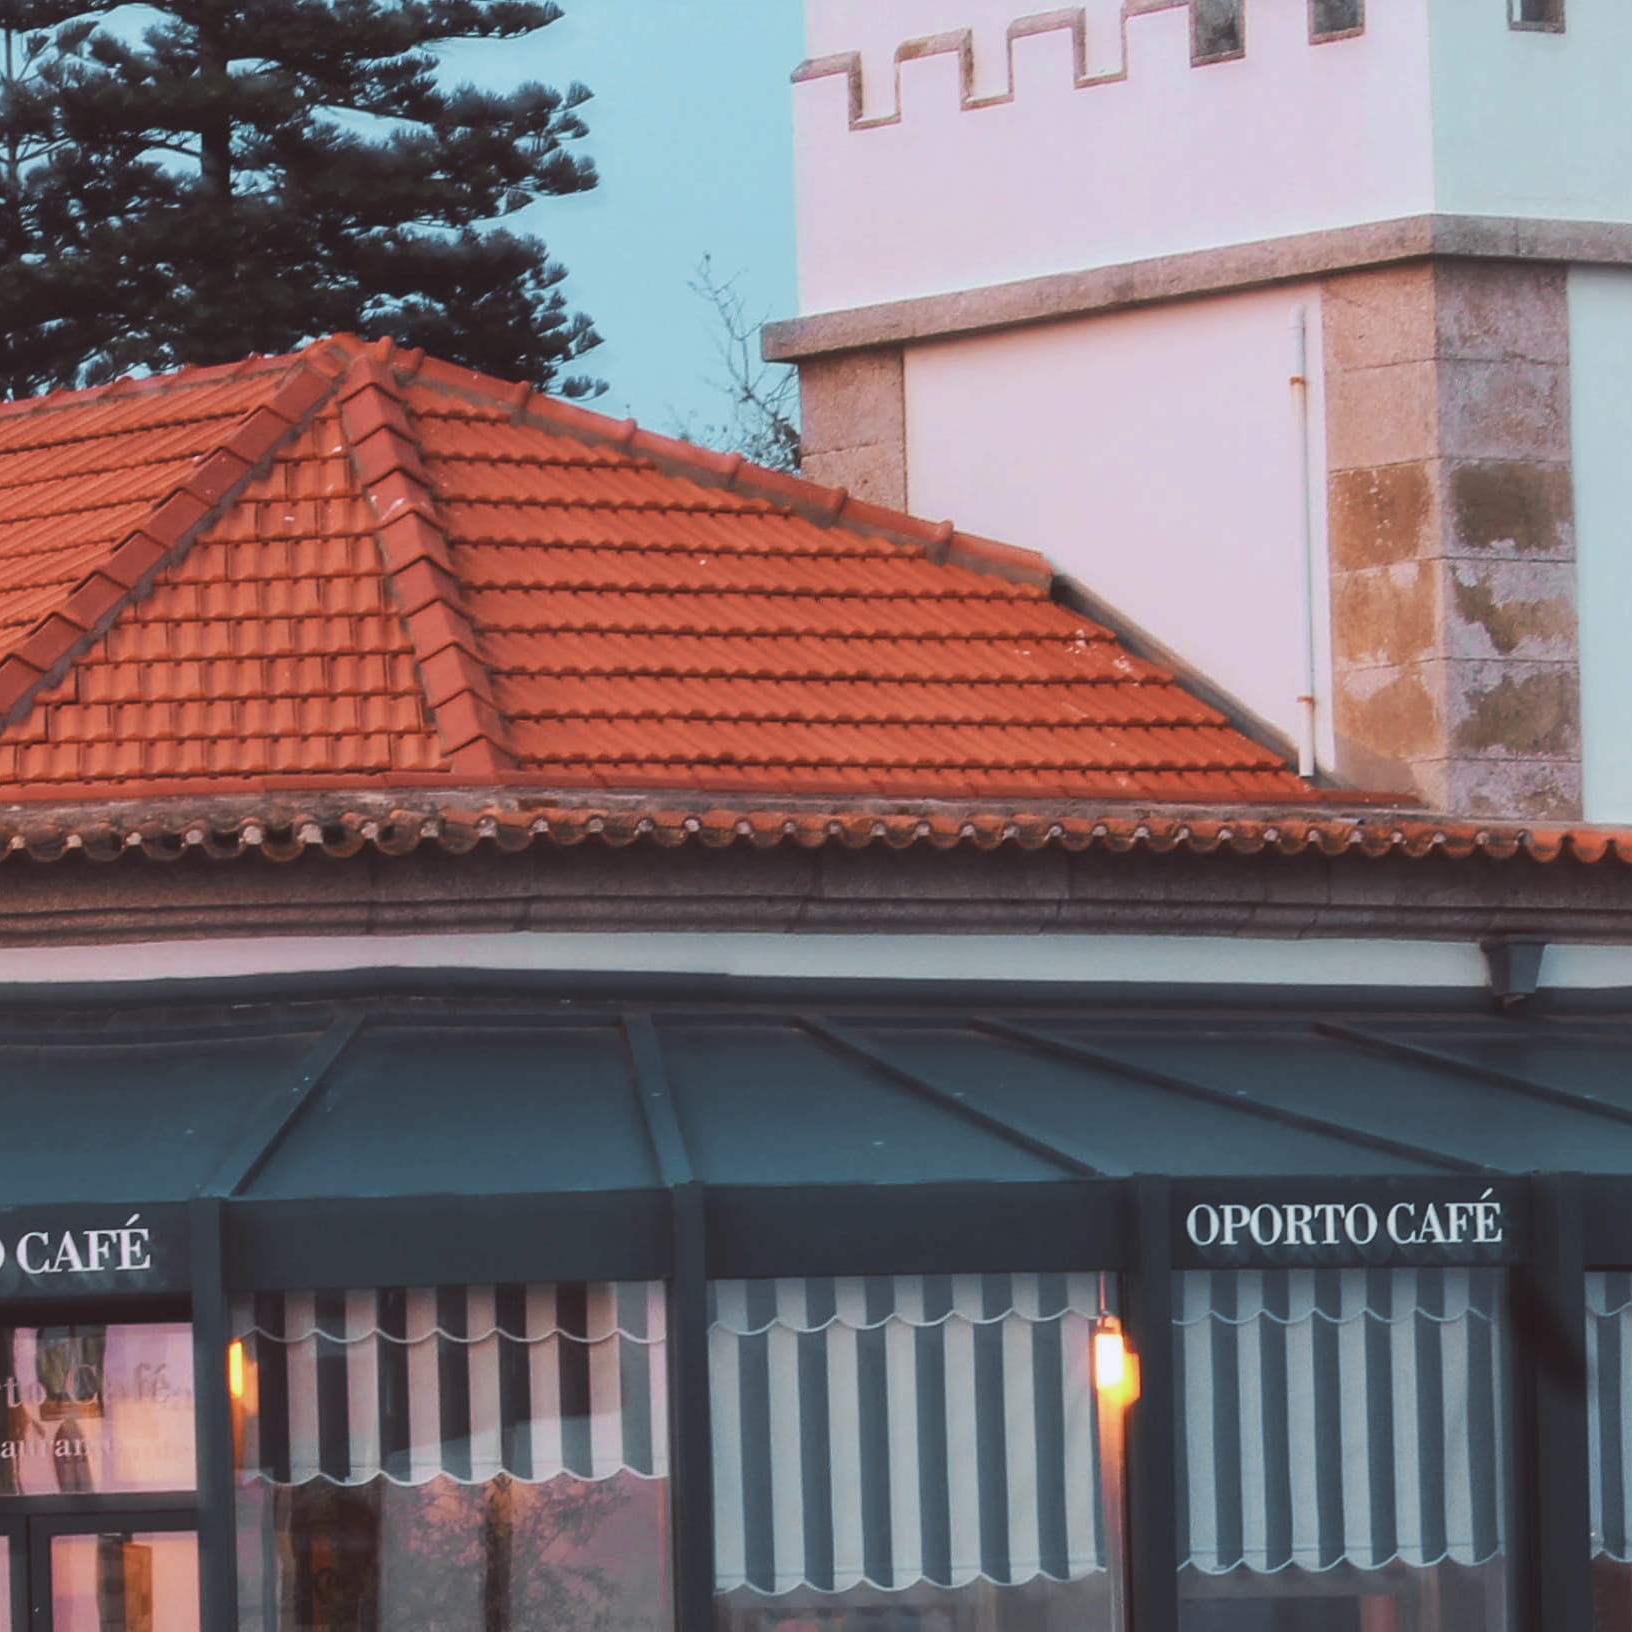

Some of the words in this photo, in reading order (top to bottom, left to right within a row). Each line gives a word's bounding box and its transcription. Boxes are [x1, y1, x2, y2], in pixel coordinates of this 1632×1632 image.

[16, 1213, 151, 1273] CAFÉ
[1186, 1203, 1378, 1246] OPORTO
[1386, 1188, 1503, 1244] CAFÉ
